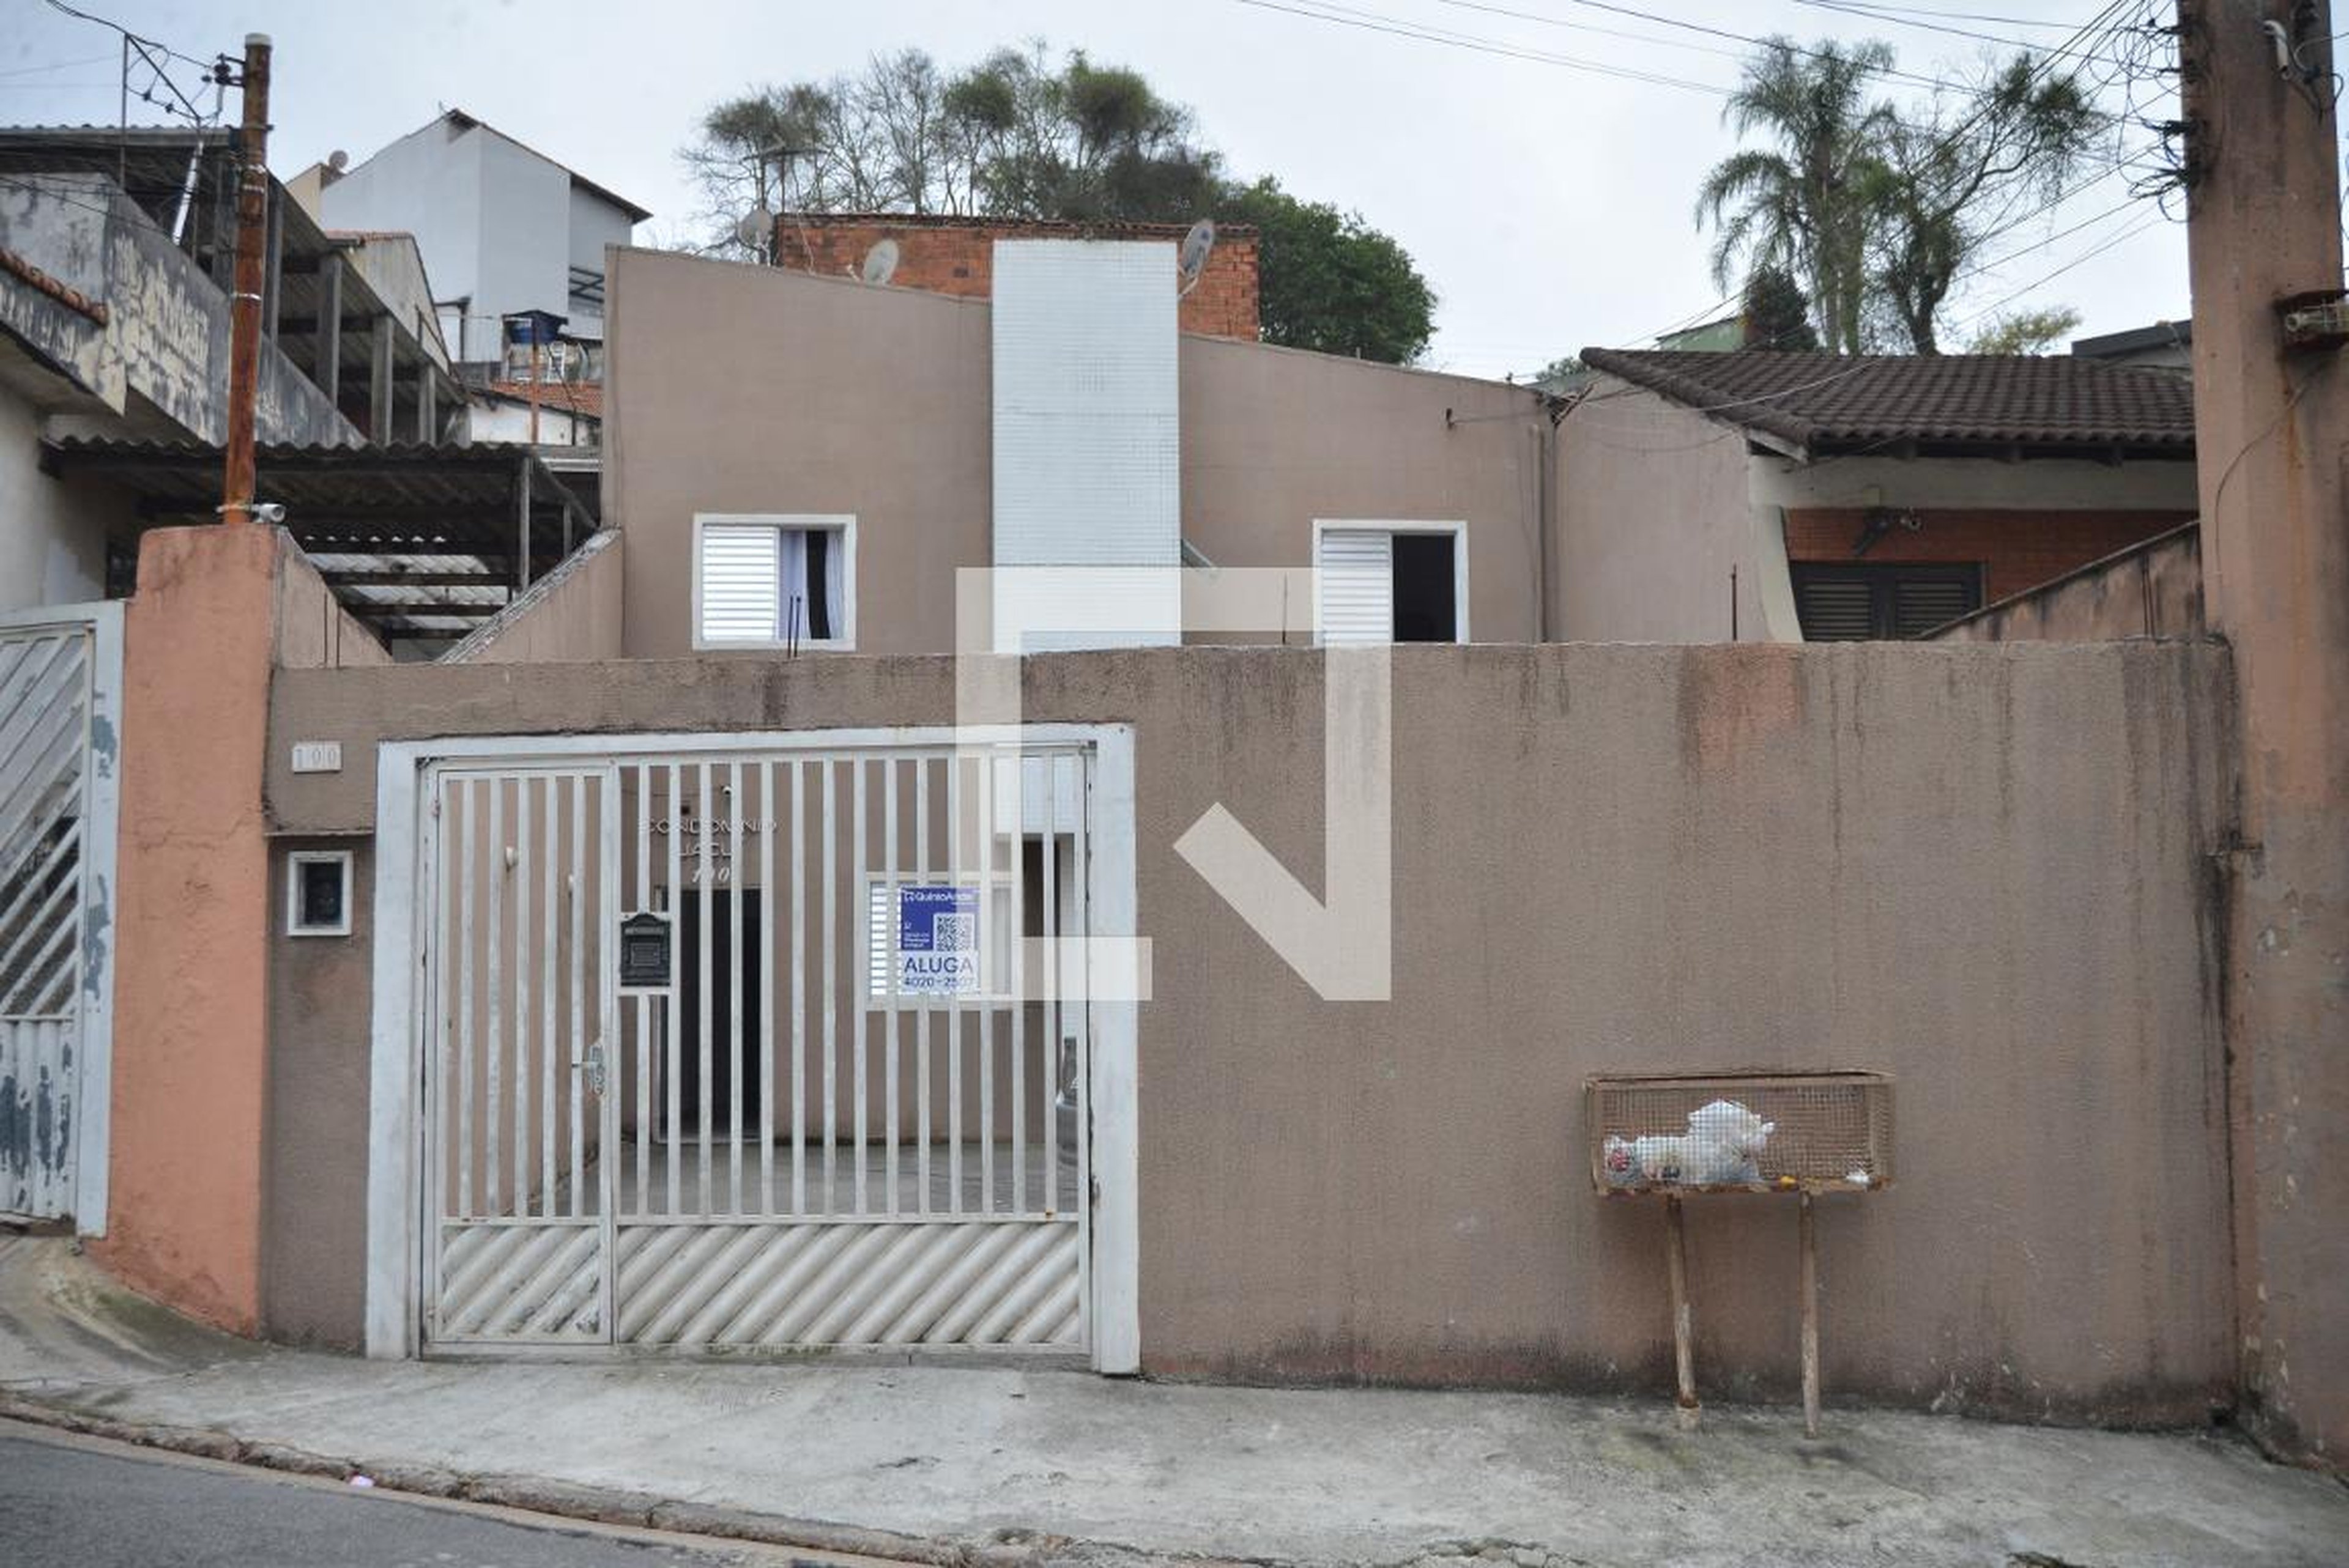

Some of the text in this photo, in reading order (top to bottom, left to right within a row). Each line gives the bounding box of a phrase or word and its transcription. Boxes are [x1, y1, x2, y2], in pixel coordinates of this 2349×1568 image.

[295, 748, 337, 767] 100
[640, 818, 777, 834] CONDOMNI
[904, 956, 973, 974] ALUGA
